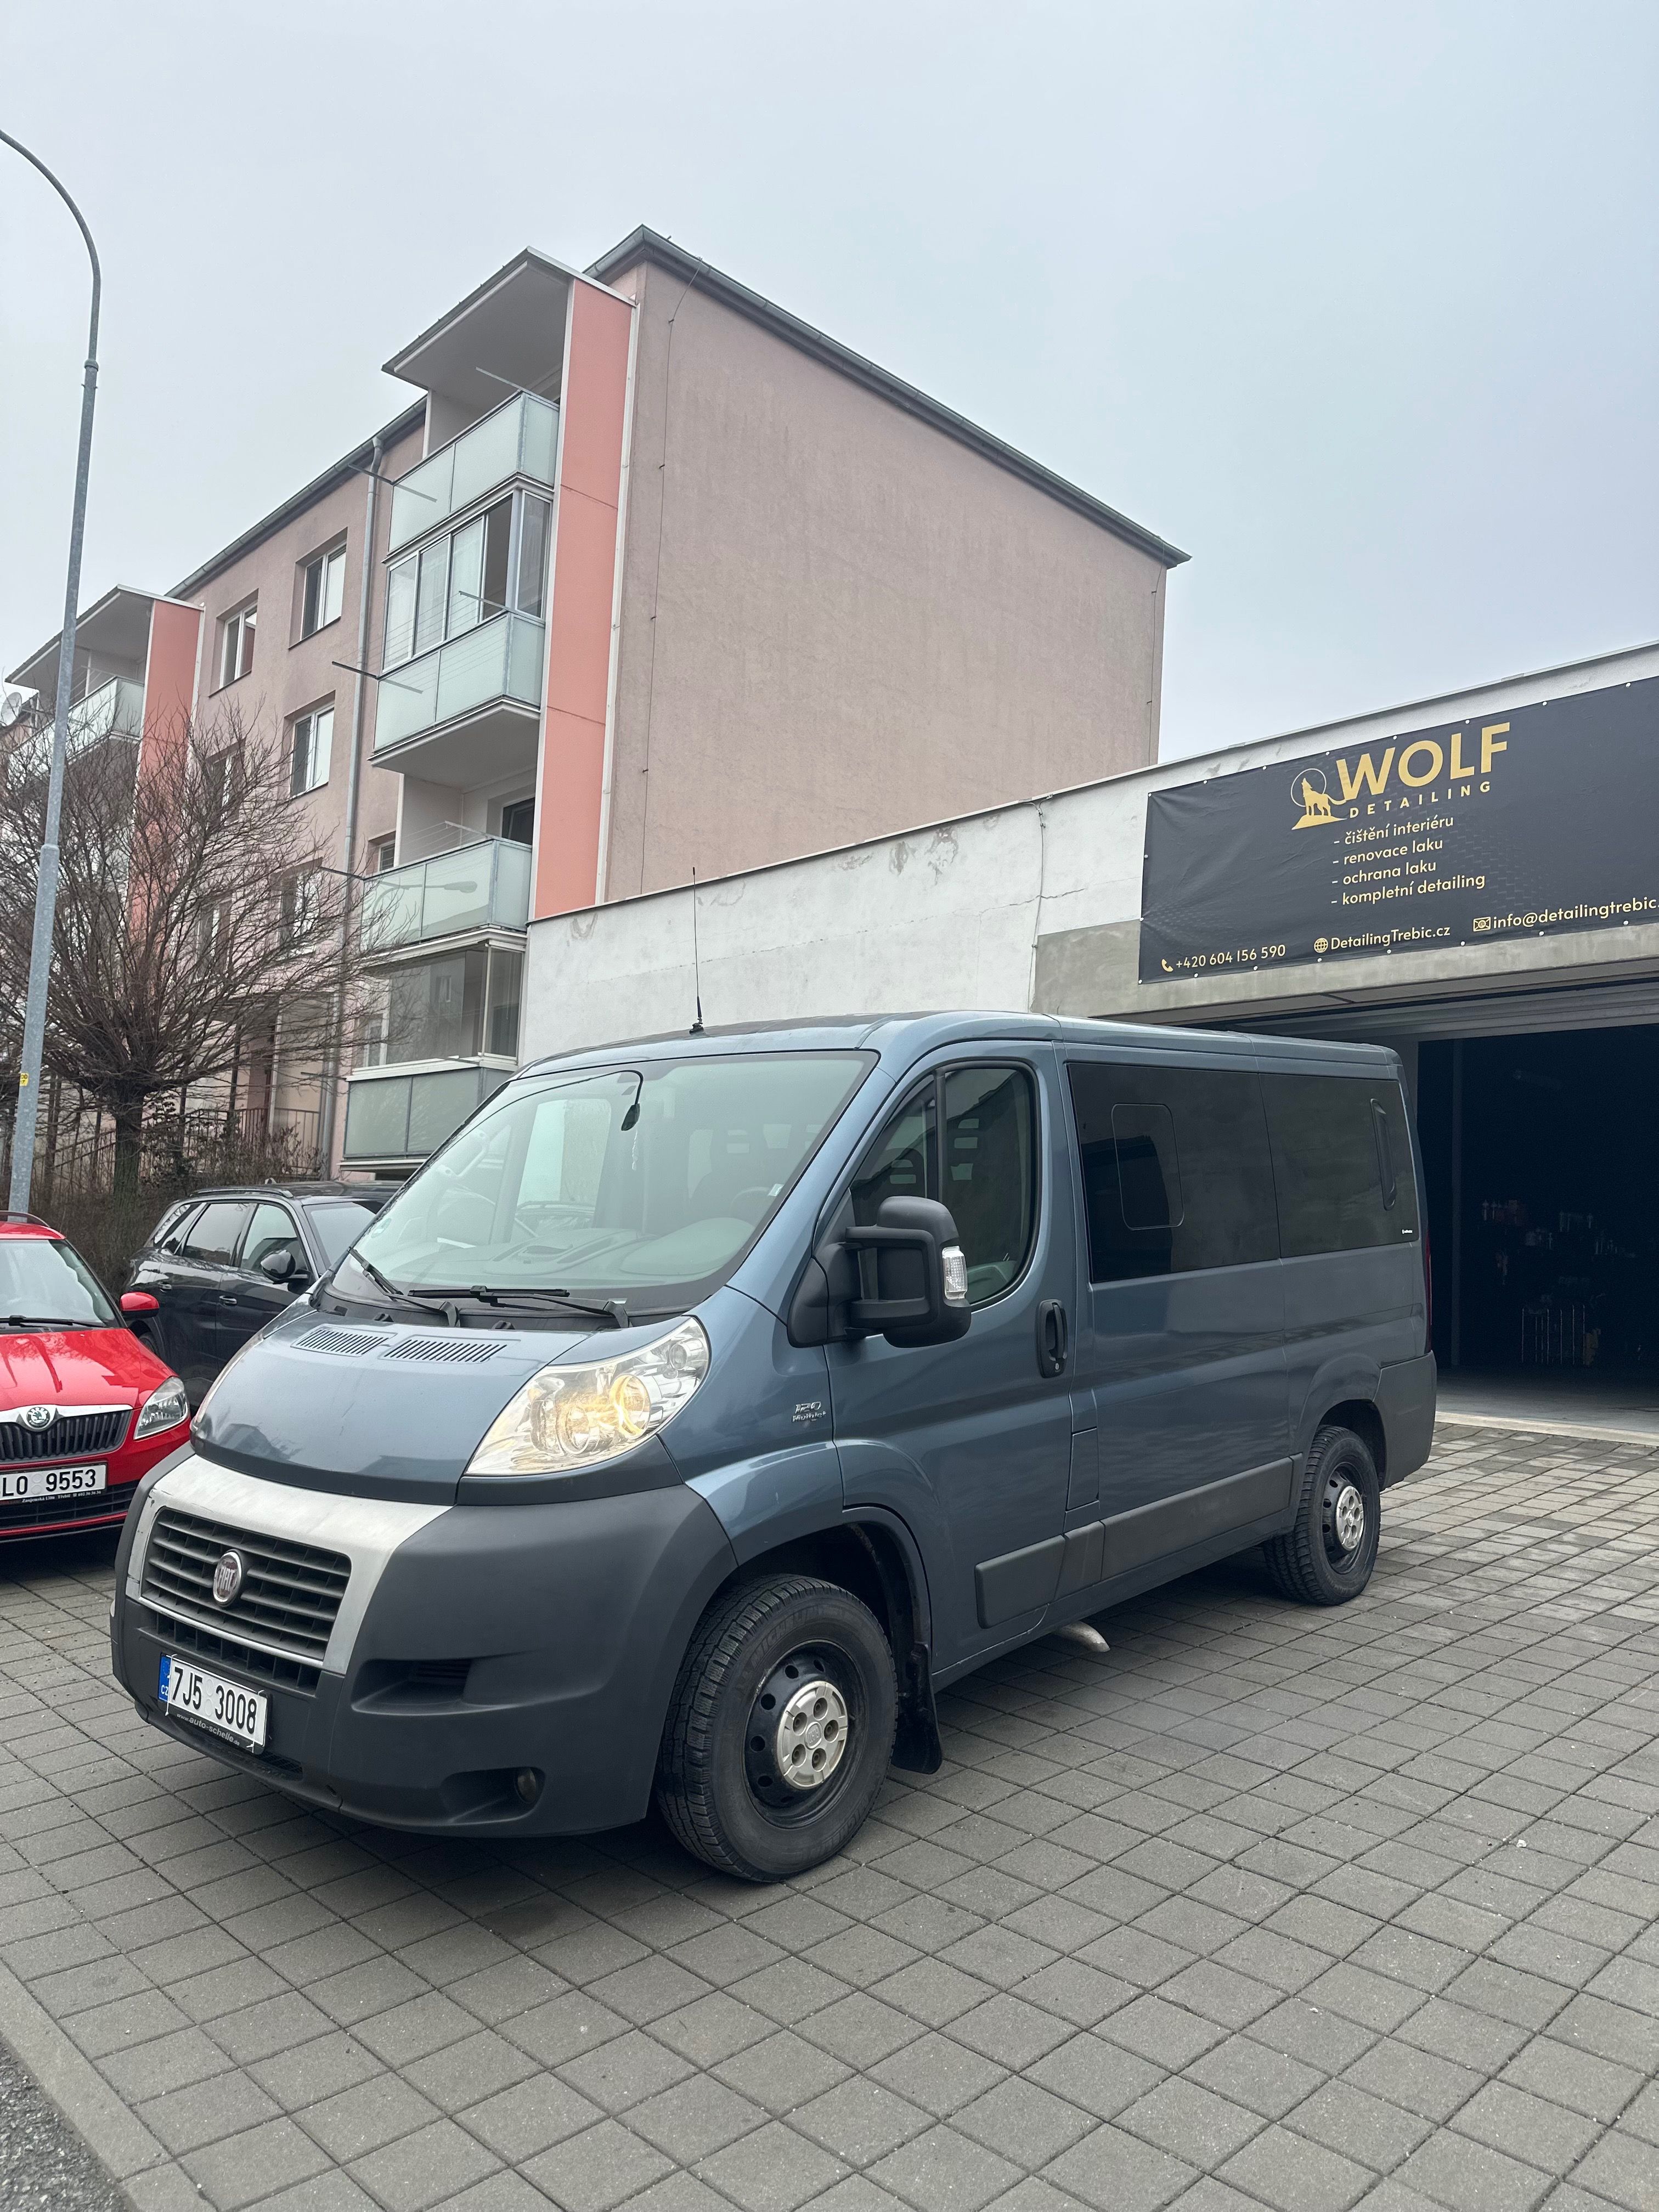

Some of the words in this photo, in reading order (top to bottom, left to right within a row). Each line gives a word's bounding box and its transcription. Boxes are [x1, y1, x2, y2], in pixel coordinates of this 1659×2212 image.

[1336, 722, 1510, 802] WOLF
[1349, 781, 1491, 819] DETAILING
[1344, 823, 1390, 845] čištění
[1393, 814, 1454, 836] interiéru
[1344, 845, 1408, 865] renovace
[1412, 838, 1443, 854] laku
[1343, 867, 1401, 885] ochrana
[1406, 860, 1437, 875] laku
[1342, 881, 1415, 905] kompletní
[1417, 874, 1486, 894] detailing
[1330, 927, 1451, 950] DetailingTrebic.cz
[1176, 955, 1206, 968] +420
[1209, 952, 1233, 966] 604
[1237, 949, 1257, 961] 156
[1261, 944, 1286, 959] 590
[795, 1401, 821, 1414] 120
[0, 1476, 28, 1497] L0
[46, 1469, 96, 1492] 9553
[218, 1566, 236, 1592] FIAT
[161, 1684, 168, 1696] CZ
[172, 1667, 203, 1710] 7J5
[215, 1685, 257, 1734] 3008
[177, 1713, 240, 1746] www.auto-schelle.de
